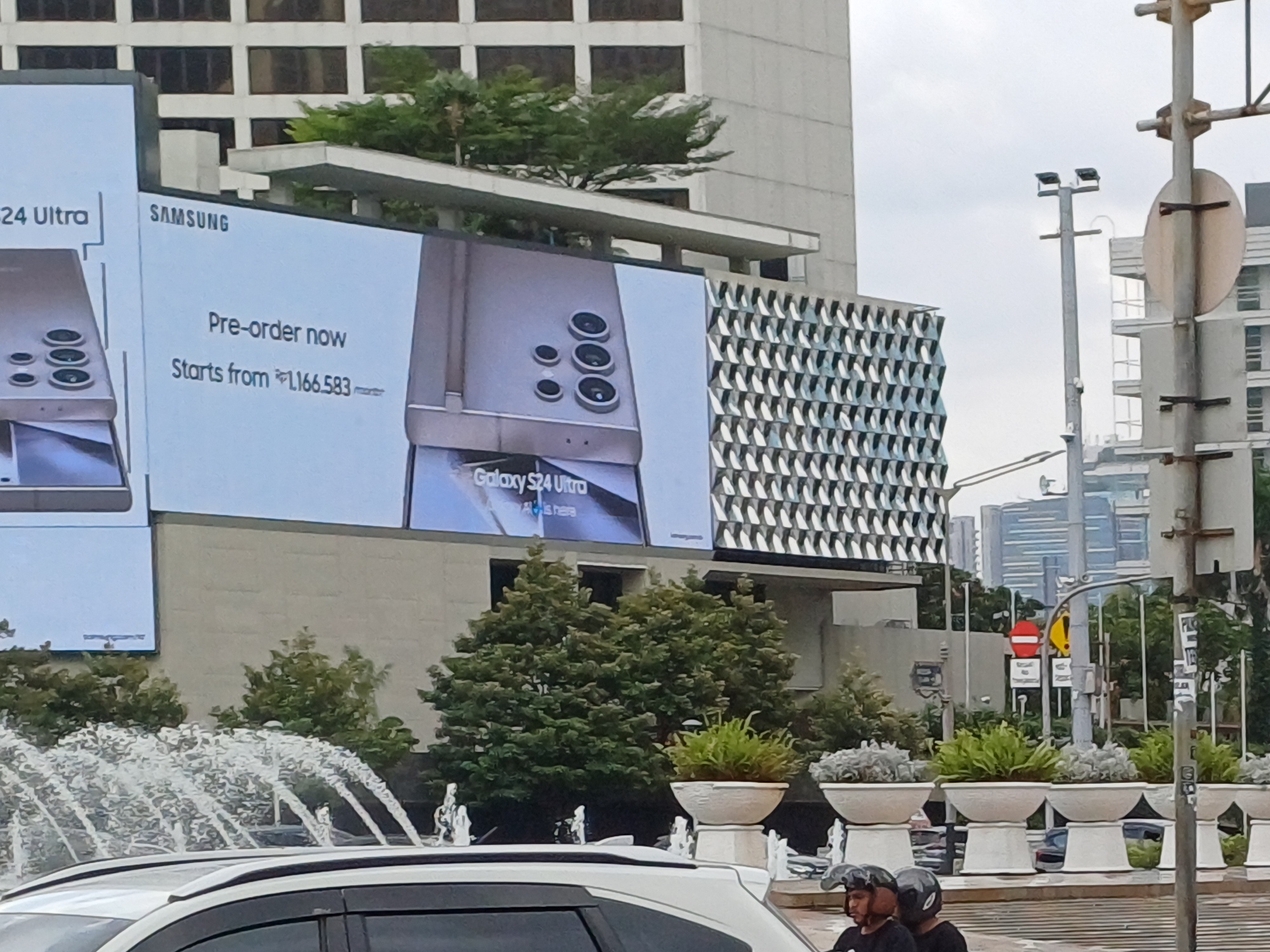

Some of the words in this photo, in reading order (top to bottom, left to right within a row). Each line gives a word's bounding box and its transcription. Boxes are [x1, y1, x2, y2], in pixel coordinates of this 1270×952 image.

[0, 207, 27, 225] 24
[33, 207, 89, 225] Ultra
[150, 204, 229, 231] SAMSUNG
[208, 311, 302, 342] Pre-order
[306, 327, 347, 348] now
[171, 358, 223, 383] Starts
[227, 362, 269, 388] from
[474, 467, 526, 495] Galaxy
[526, 472, 552, 492] S24
[554, 474, 588, 495] Ultra
